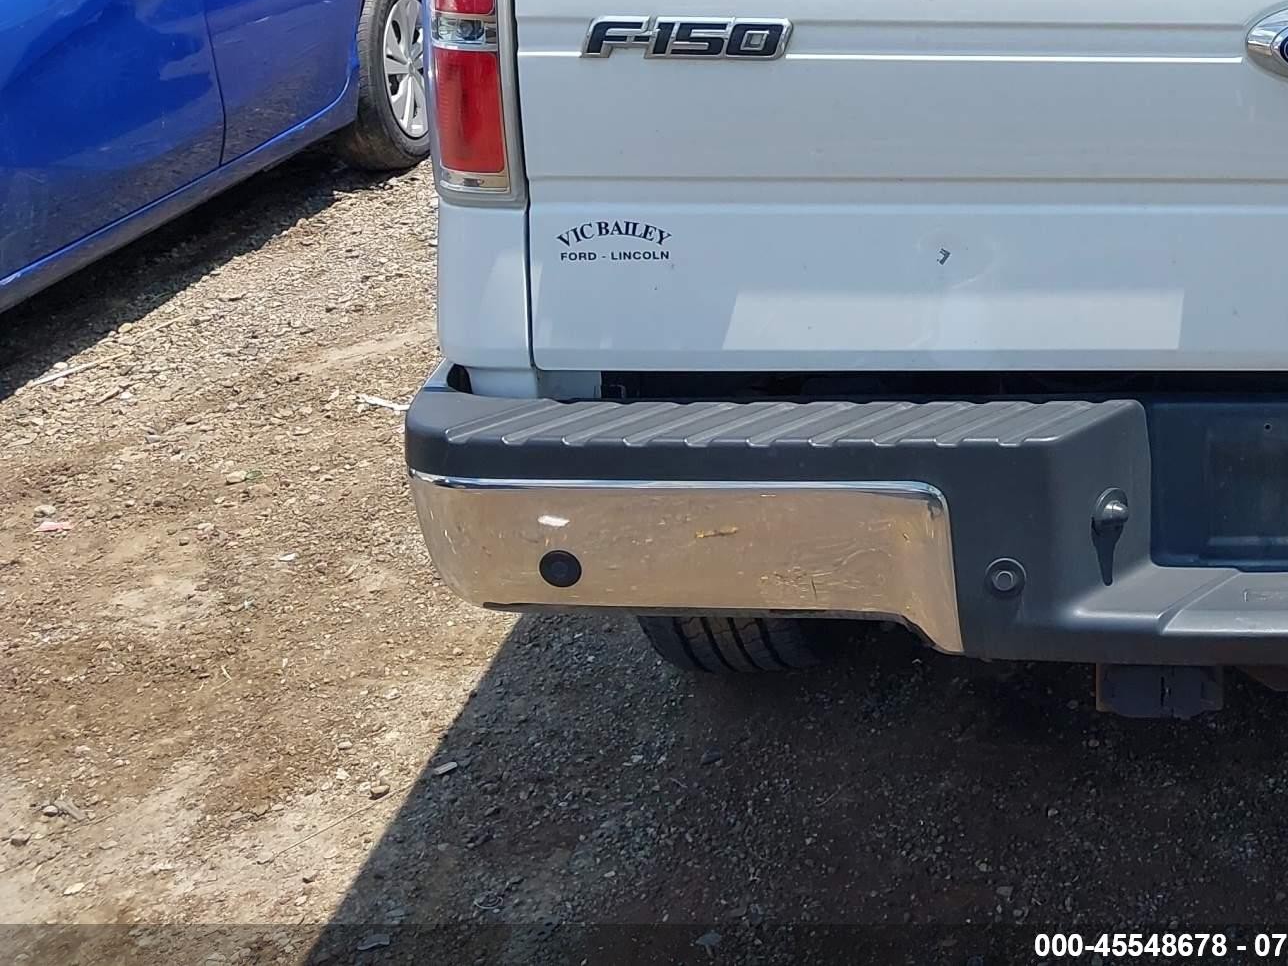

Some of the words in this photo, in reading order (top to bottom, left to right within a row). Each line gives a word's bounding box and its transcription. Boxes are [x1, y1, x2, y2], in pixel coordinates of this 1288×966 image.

[580, 15, 793, 59] F-150
[556, 222, 595, 247] VIC
[596, 219, 672, 245] BAILEY
[560, 251, 597, 262] FORD
[610, 250, 669, 261] LINCOLN
